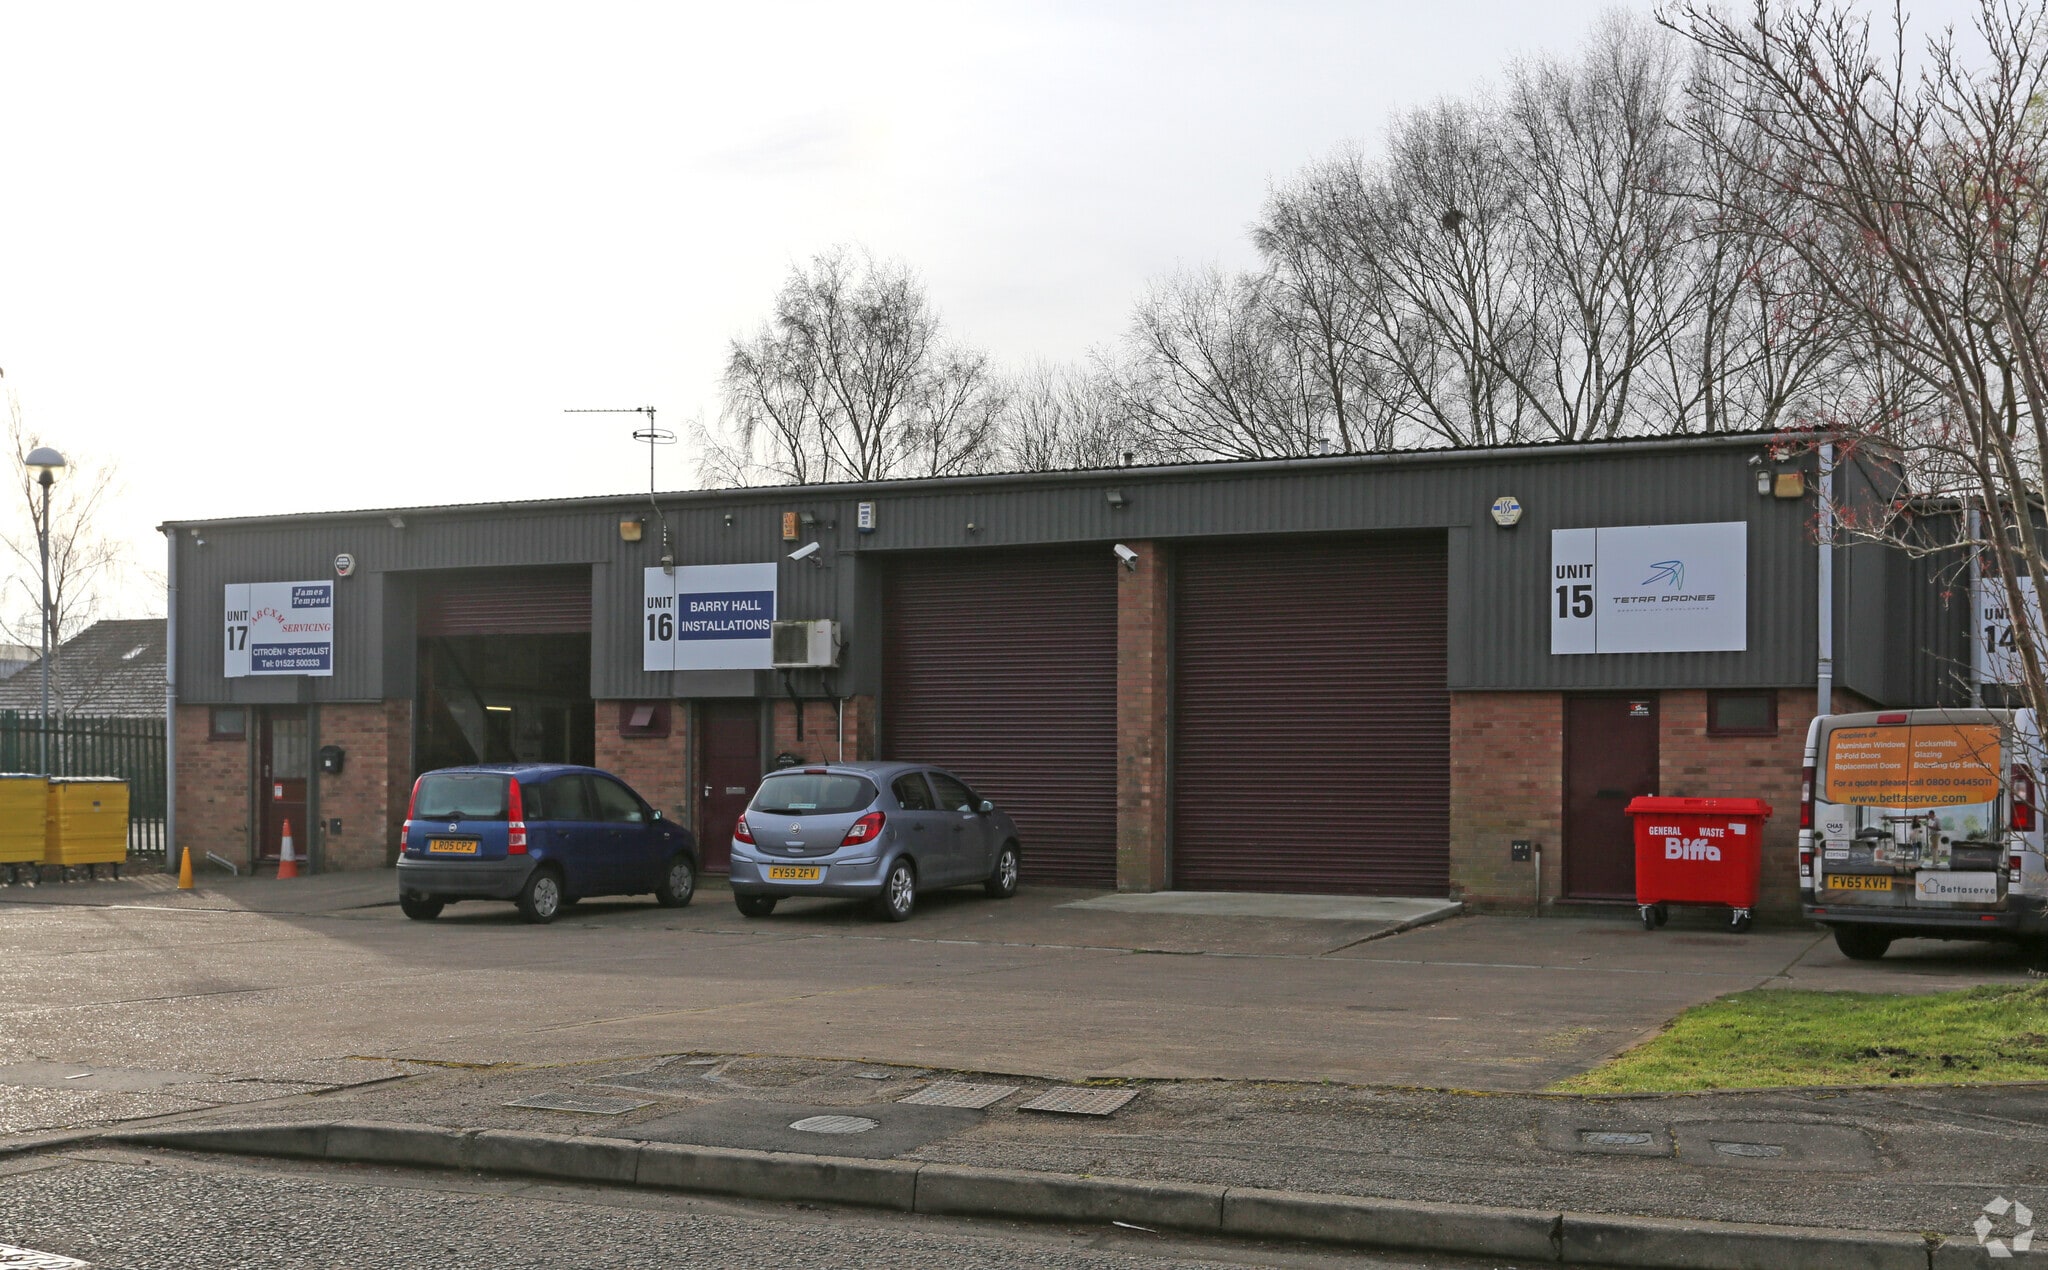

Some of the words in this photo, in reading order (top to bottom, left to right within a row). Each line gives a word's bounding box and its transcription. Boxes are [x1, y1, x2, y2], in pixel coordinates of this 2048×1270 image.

[1556, 564, 1593, 579] UNIT
[295, 588, 324, 596] James
[293, 597, 330, 606] Tempest
[647, 596, 673, 608] UNIT
[1556, 584, 1593, 618] 15
[1613, 596, 1656, 604] TETRA
[1661, 594, 1716, 602] DRONES
[690, 601, 729, 612] BARRY
[732, 600, 762, 611] HALL
[227, 610, 248, 621] UNIT
[1985, 608, 2010, 620] UNI
[282, 623, 331, 632] SERVICING
[647, 613, 673, 641] 16
[682, 619, 770, 632] INSTALLATIONS
[227, 626, 248, 651] 17
[1984, 625, 2017, 653] 14
[287, 647, 329, 656] SPECIALIST
[262, 660, 275, 668] Tel:
[1914, 751, 1942, 759] Glazing
[1834, 763, 1878, 771] Replacement
[1855, 779, 1878, 788] quote
[1880, 779, 1907, 787] please
[1909, 778, 1924, 786] call
[1926, 778, 1951, 786] 0800
[1850, 792, 1967, 803] www.bettaserve.com
[1649, 826, 1682, 836] GENERAL
[1699, 827, 1725, 838] WASTE
[433, 840, 453, 850] LR05
[456, 841, 473, 851] CPZ
[1665, 837, 1721, 861] Biffa
[772, 867, 796, 878] FY59
[797, 868, 816, 878] ZFV
[1832, 876, 1862, 888] FV65
[1864, 877, 1887, 889] KVH
[1940, 885, 1996, 894] Bettaserve
